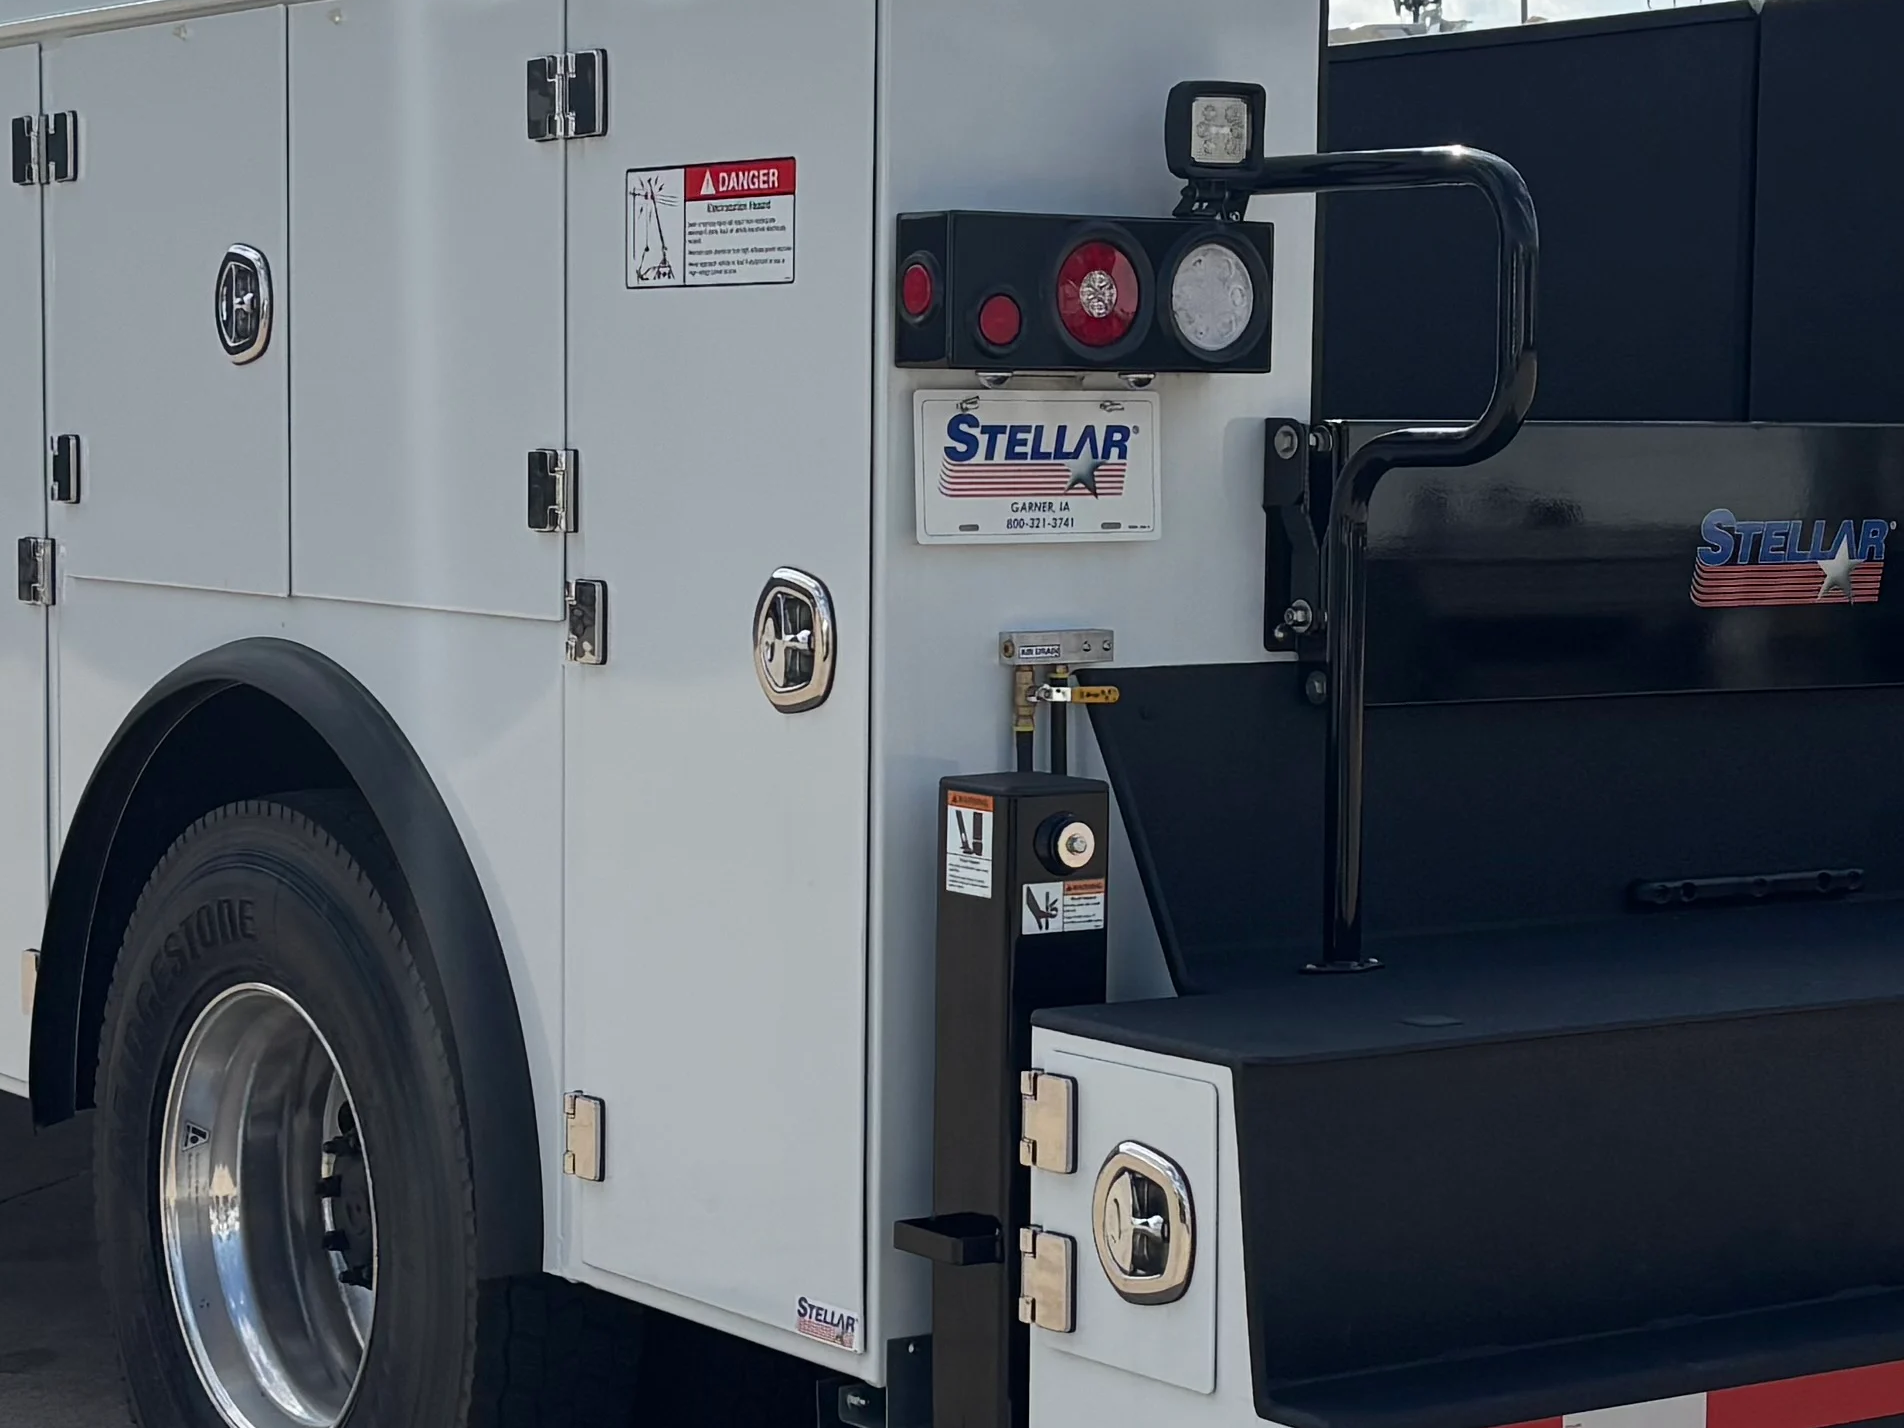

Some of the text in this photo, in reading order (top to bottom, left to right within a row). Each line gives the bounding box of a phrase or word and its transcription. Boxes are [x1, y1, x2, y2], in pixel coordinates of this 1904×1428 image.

[718, 168, 779, 192] DANGER
[943, 413, 1131, 462] STELLAR
[1059, 500, 1071, 512] IA
[1006, 516, 1075, 530] 800-321-3741
[1696, 508, 1890, 567] STELLAR
[797, 1296, 856, 1334] STELLAR
